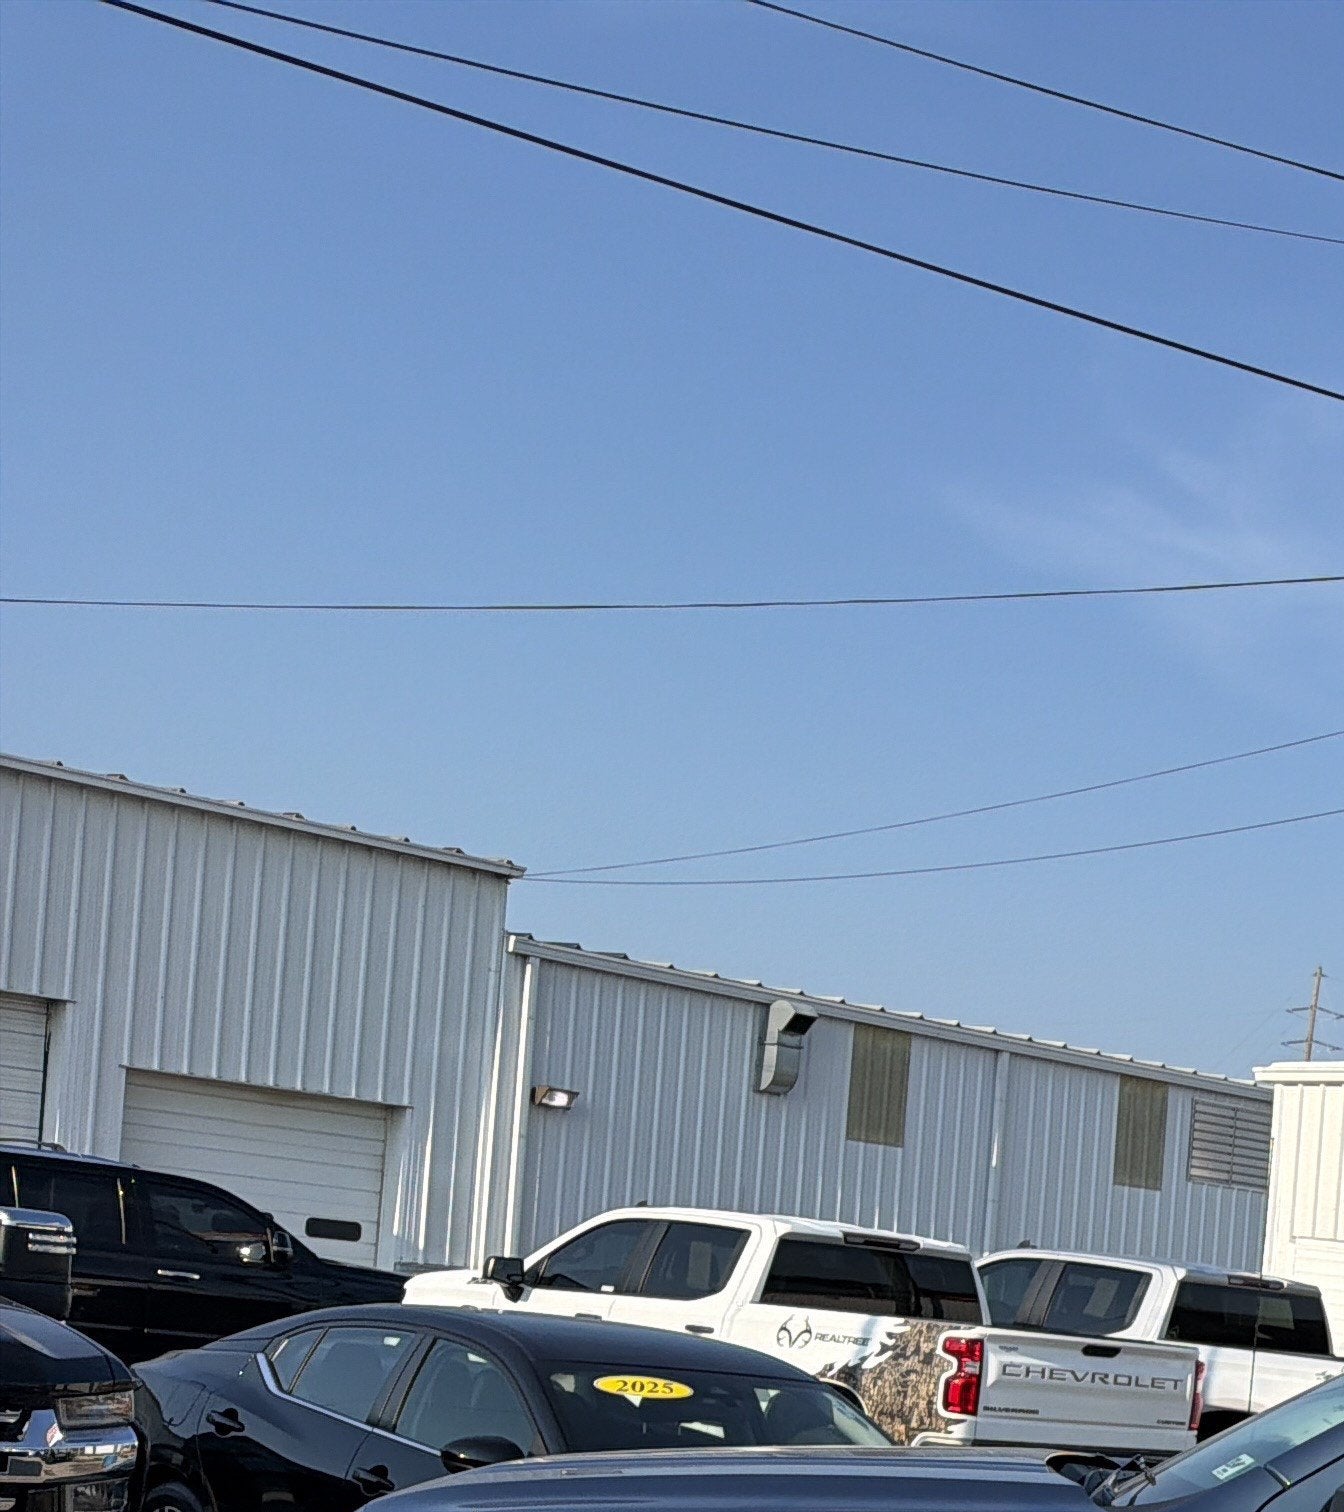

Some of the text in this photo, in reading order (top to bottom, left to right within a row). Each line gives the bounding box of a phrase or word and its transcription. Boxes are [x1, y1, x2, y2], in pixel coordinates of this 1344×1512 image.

[814, 1333, 871, 1347] REALTREE
[1002, 1362, 1184, 1391] CHEVROLET
[616, 1379, 674, 1394] 2025
